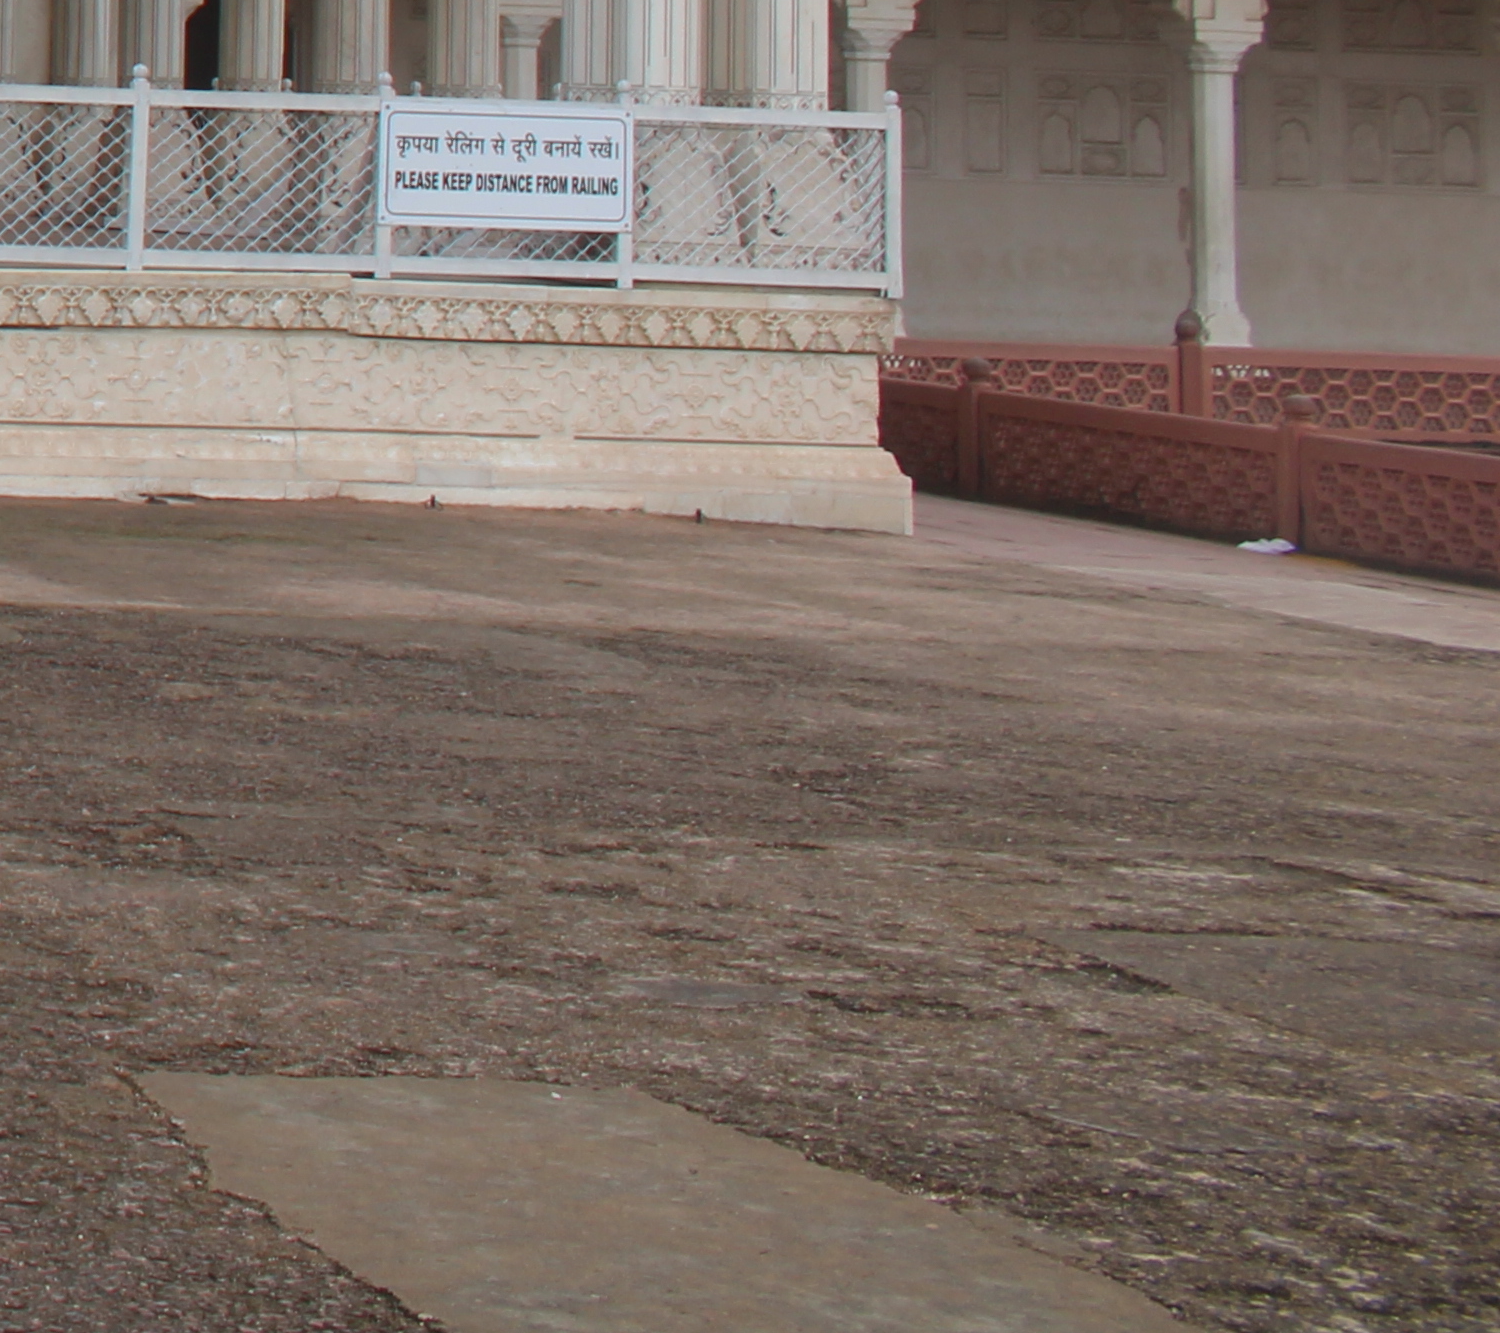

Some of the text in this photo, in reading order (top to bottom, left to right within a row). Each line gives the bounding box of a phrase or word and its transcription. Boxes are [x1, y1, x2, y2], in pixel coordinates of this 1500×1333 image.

[395, 135, 439, 158] कृपया
[445, 130, 485, 155] रेलिंग
[490, 132, 505, 155] से
[511, 132, 537, 163] दूरी
[395, 170, 619, 196] PLEASE KEEP DISTANCE FROM RAILING
